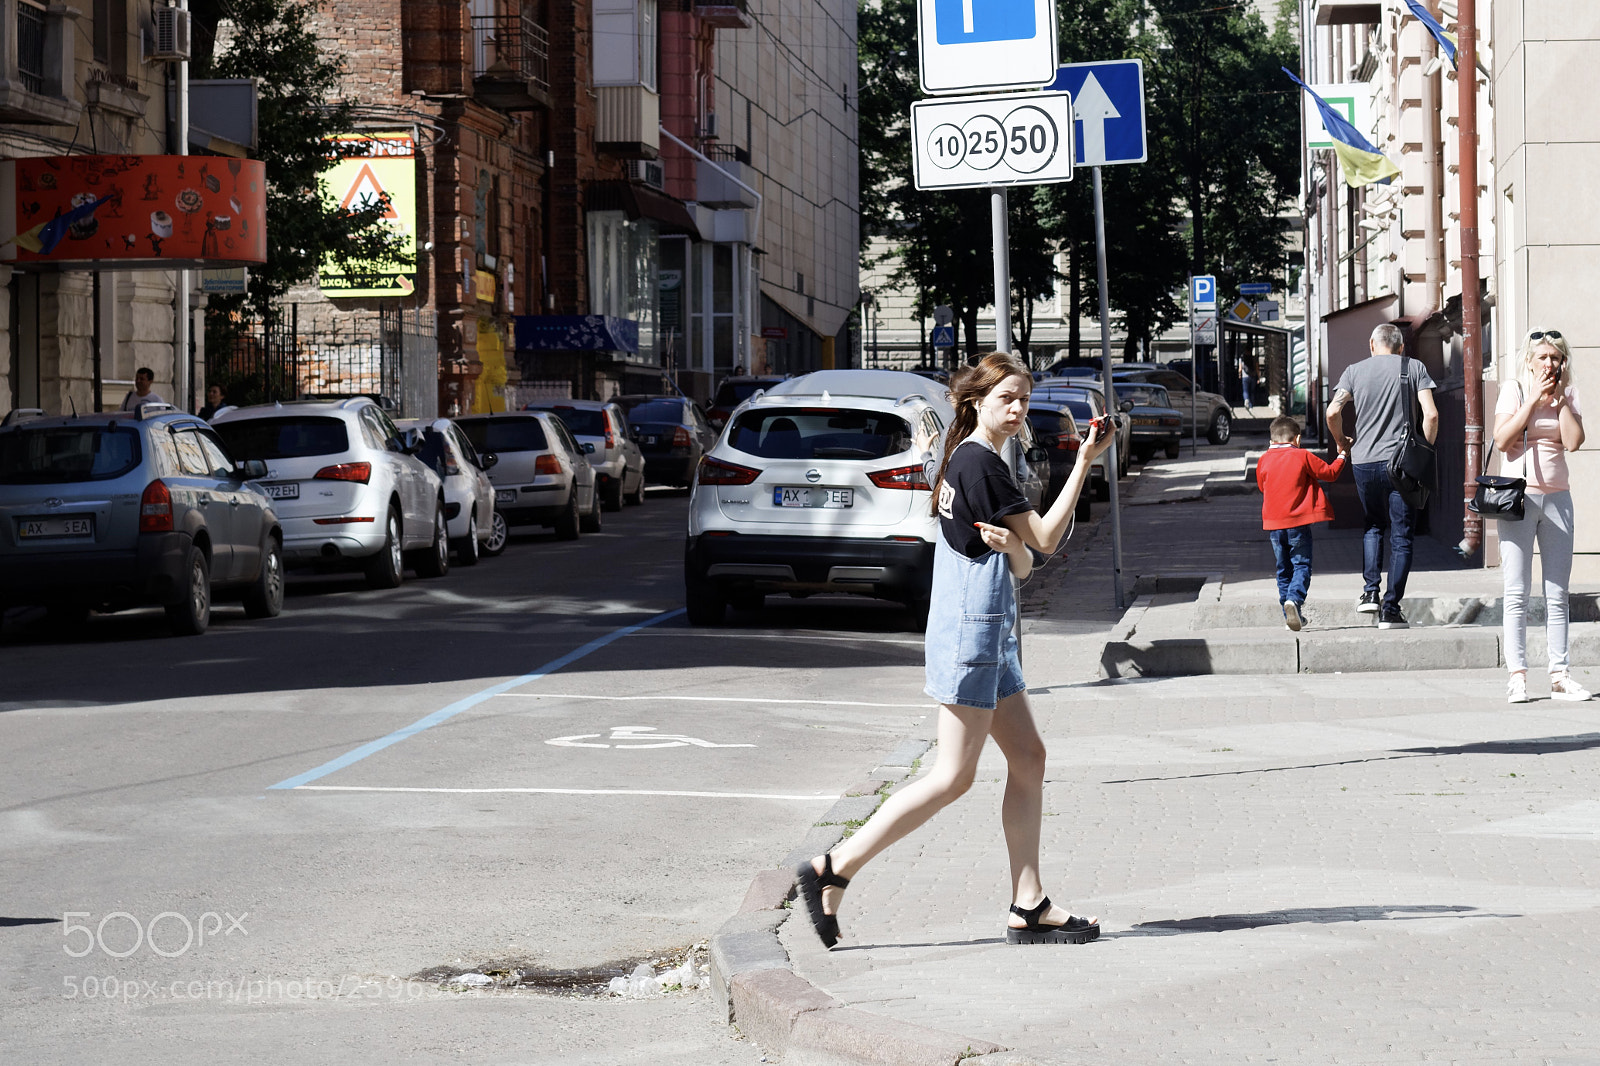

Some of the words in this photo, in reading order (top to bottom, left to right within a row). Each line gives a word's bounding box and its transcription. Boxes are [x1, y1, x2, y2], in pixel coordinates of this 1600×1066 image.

[934, 135, 960, 157] 10
[968, 130, 999, 155] 25
[1010, 124, 1047, 155] 50
[1195, 278, 1211, 301] P
[783, 489, 800, 502] AX
[832, 490, 849, 503] EE
[27, 523, 43, 535] AX
[72, 521, 88, 533] EA
